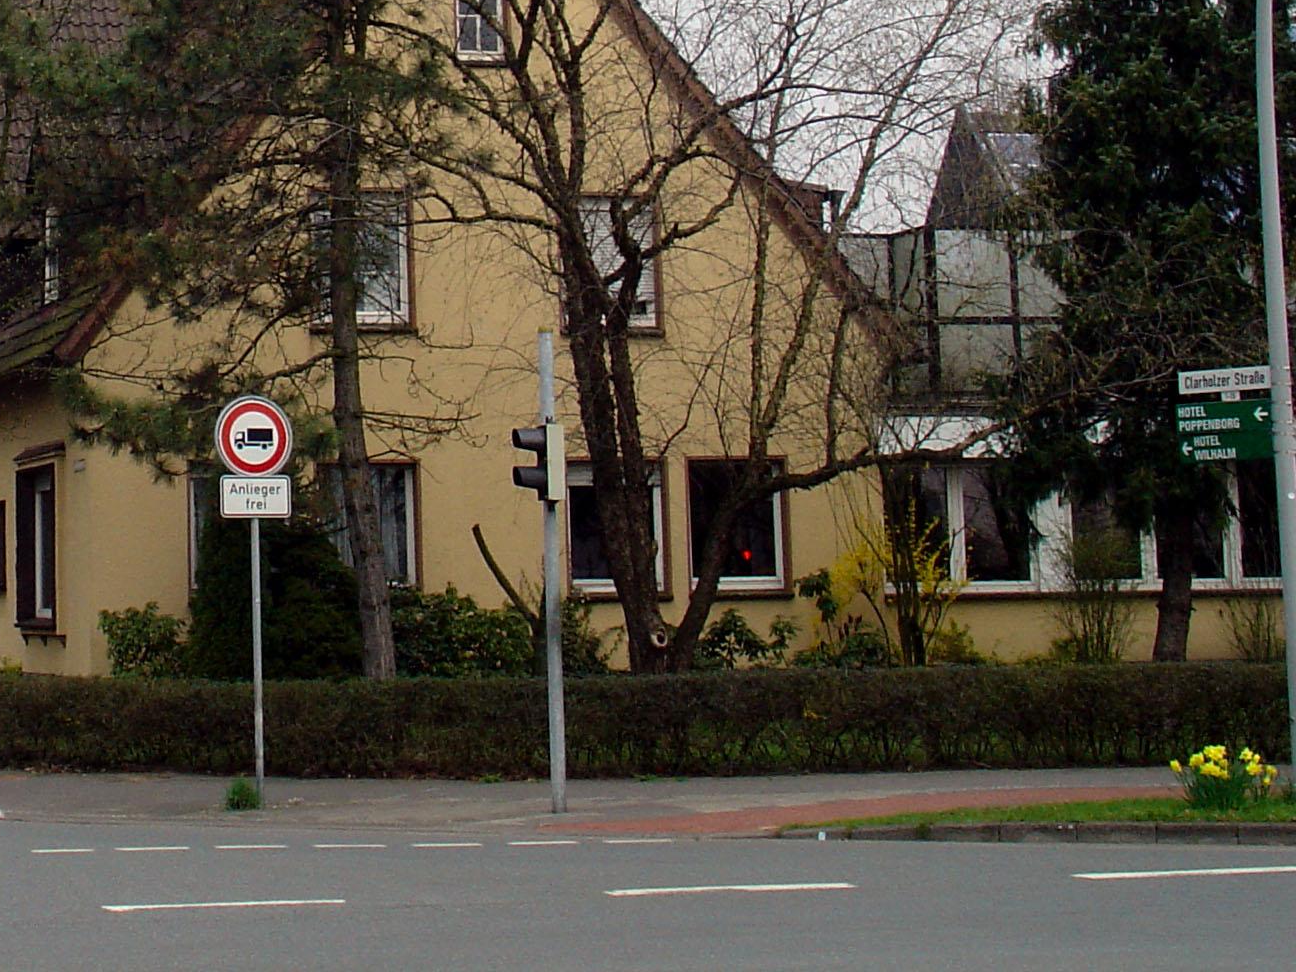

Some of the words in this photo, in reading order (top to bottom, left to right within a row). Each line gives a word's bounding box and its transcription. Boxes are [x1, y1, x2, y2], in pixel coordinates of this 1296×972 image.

[1184, 375, 1230, 389] Clarholzer
[1234, 371, 1265, 385] Straße
[1178, 406, 1206, 418] HOTEL
[1179, 418, 1240, 432] POPPENBORG
[1193, 435, 1221, 447] HOTEL
[1194, 448, 1236, 461] WILHALM
[230, 483, 280, 497] Anlieger
[246, 498, 267, 510] frei
